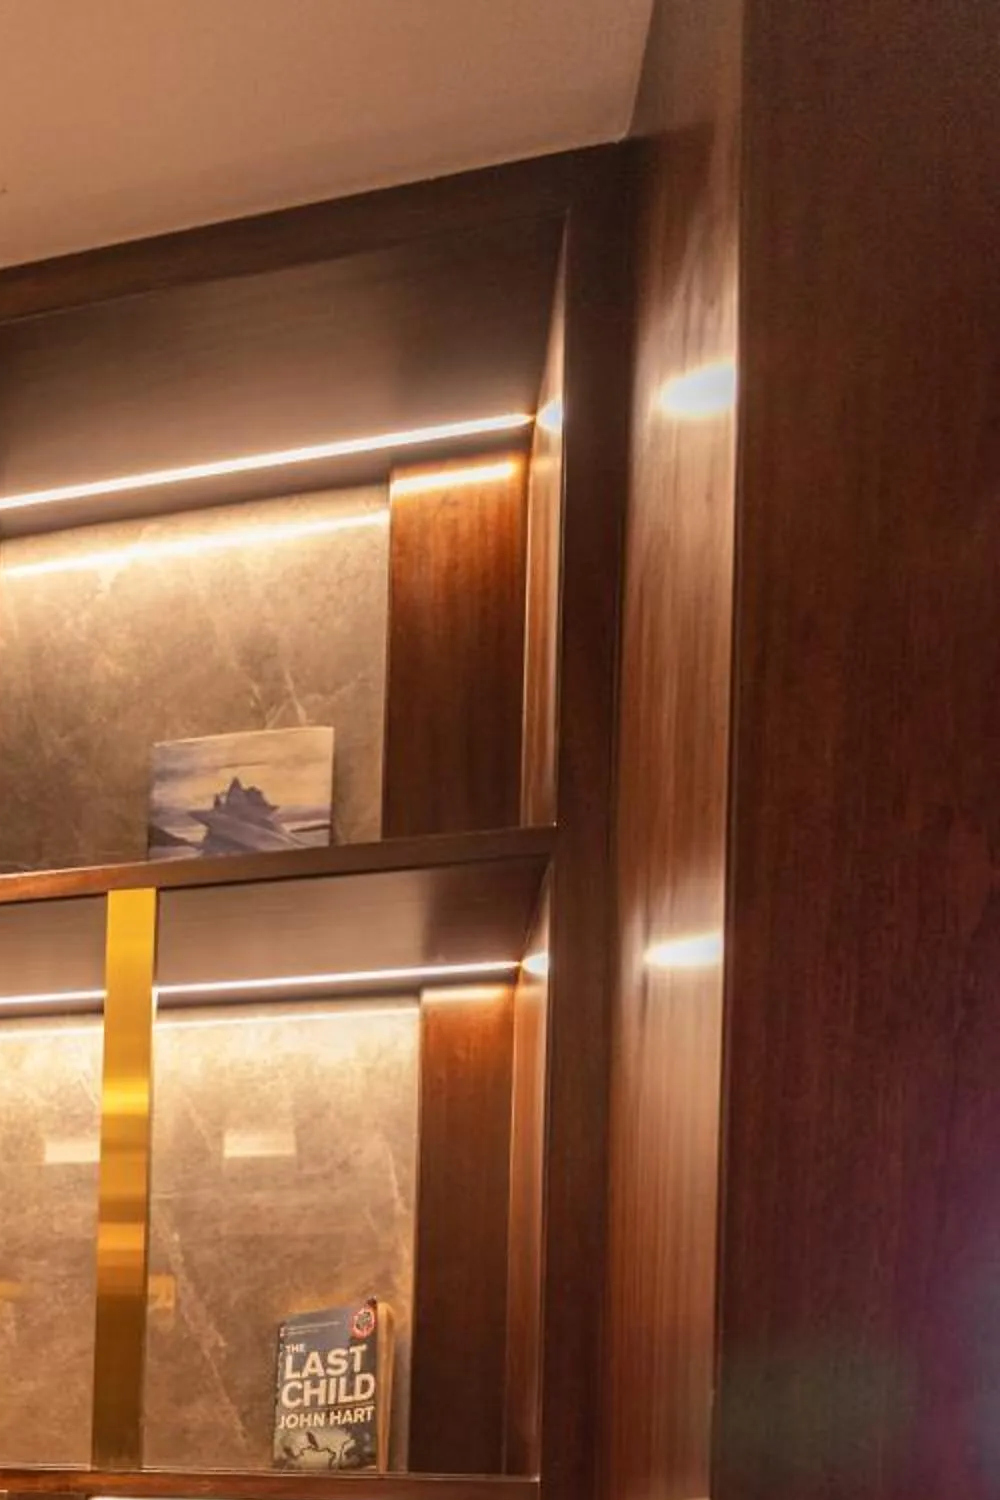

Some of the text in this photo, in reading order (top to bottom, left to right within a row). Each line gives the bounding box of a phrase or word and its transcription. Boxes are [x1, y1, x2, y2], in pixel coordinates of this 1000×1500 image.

[284, 1345, 368, 1379] LAST
[285, 1344, 305, 1353] THE
[281, 1373, 376, 1409] CHILD
[279, 1405, 376, 1430] JOHN HART
